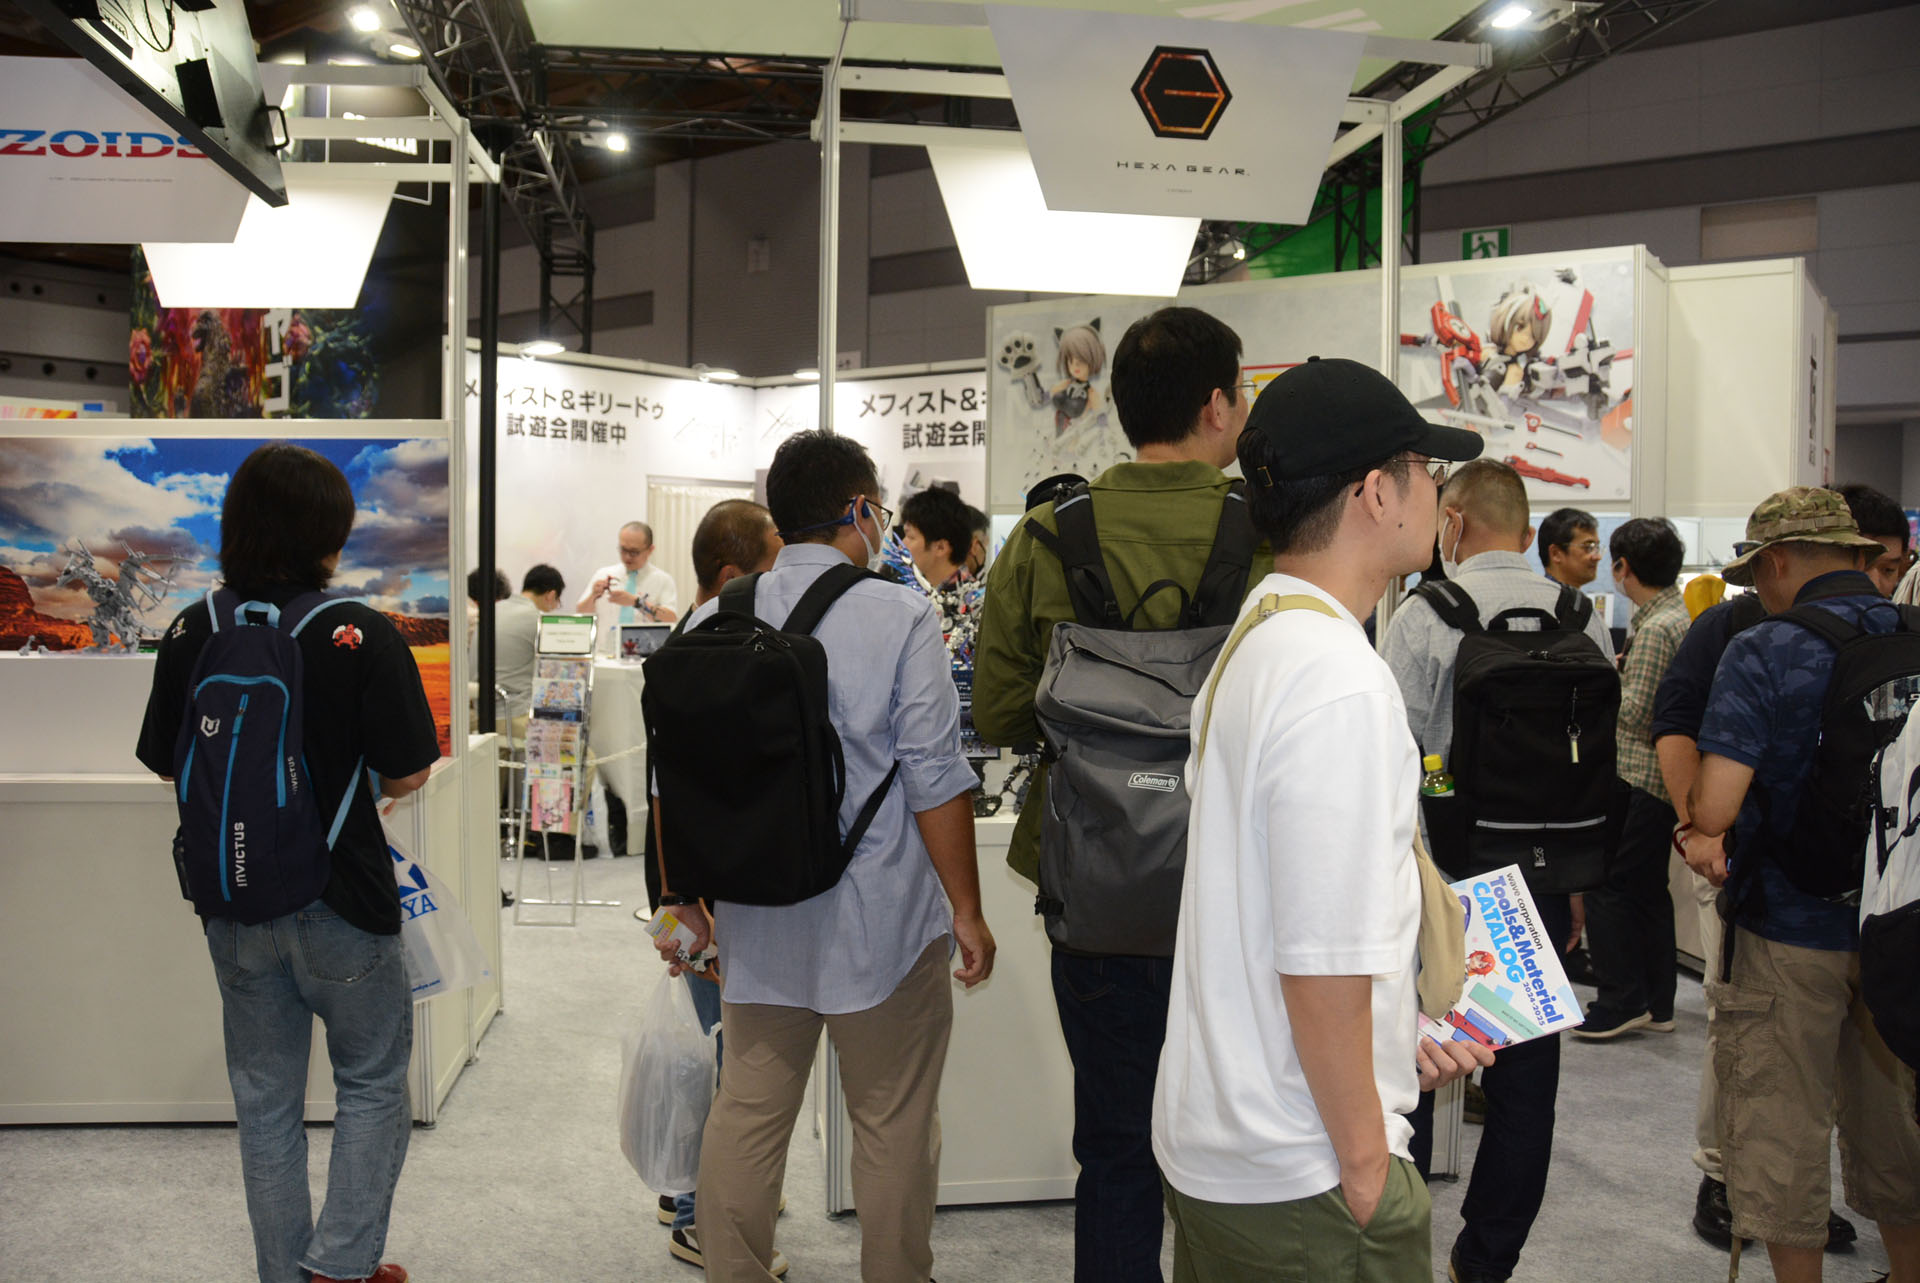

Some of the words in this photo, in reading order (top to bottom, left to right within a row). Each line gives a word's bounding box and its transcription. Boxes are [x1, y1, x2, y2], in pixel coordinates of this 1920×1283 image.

[1117, 161, 1177, 171] HEXA
[464, 378, 664, 420] メィスト&ギリードゥ
[859, 387, 987, 418] メフィスト&
[506, 412, 627, 445] 試遊会開催中
[1132, 774, 1168, 787] Coleman
[400, 893, 438, 924] YA
[1506, 872, 1521, 897] wave
[1517, 898, 1544, 950] corporation
[1473, 881, 1526, 983] CATALOG
